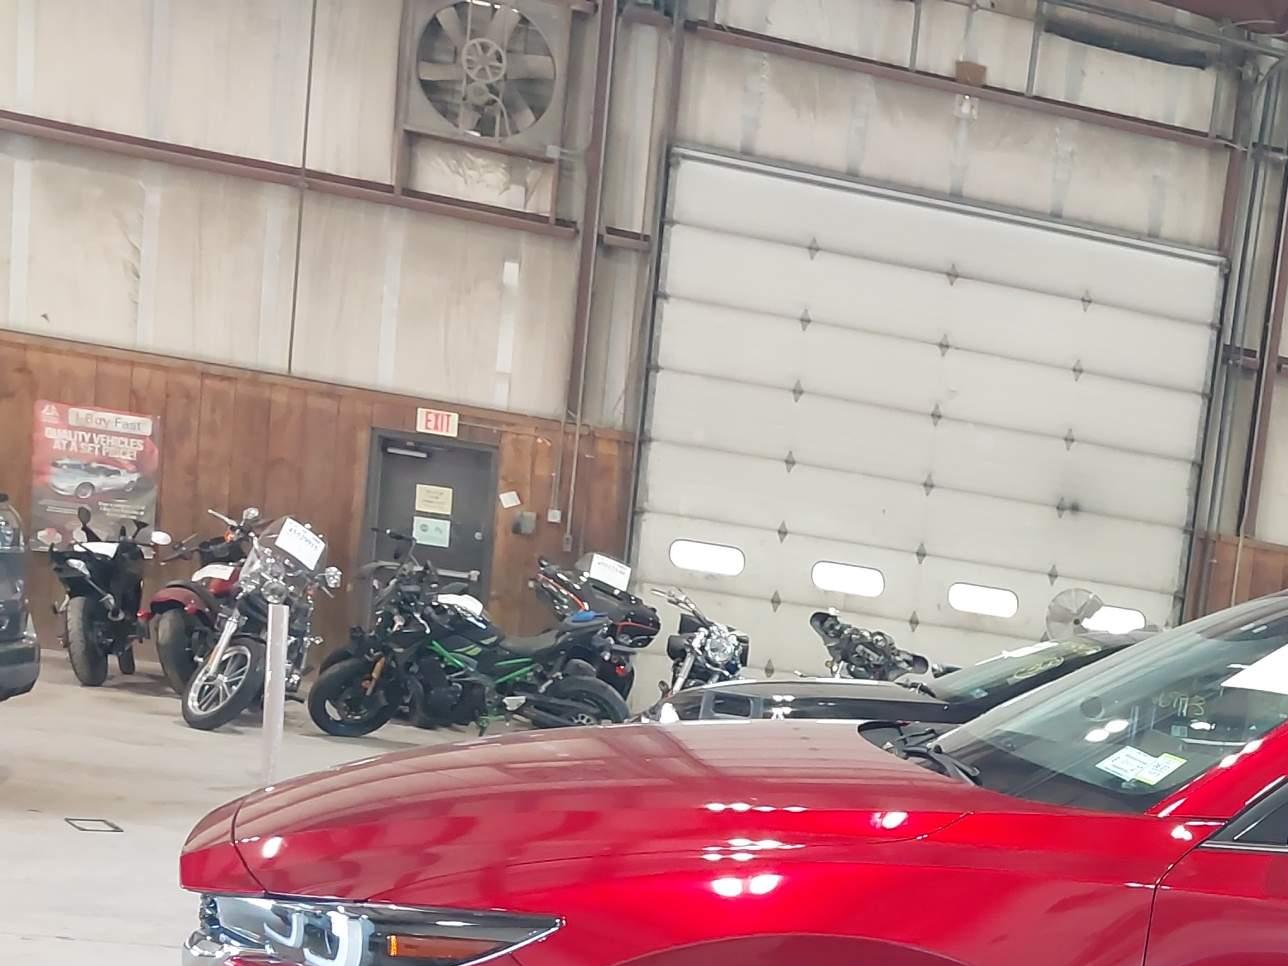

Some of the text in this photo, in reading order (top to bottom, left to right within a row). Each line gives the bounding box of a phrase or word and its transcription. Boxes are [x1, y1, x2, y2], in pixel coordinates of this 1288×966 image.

[114, 416, 143, 431] Fast
[424, 411, 451, 433] EXIT
[45, 427, 145, 451] QUALITY VEHICLES
[53, 440, 68, 450] AT
[80, 443, 100, 457] SET
